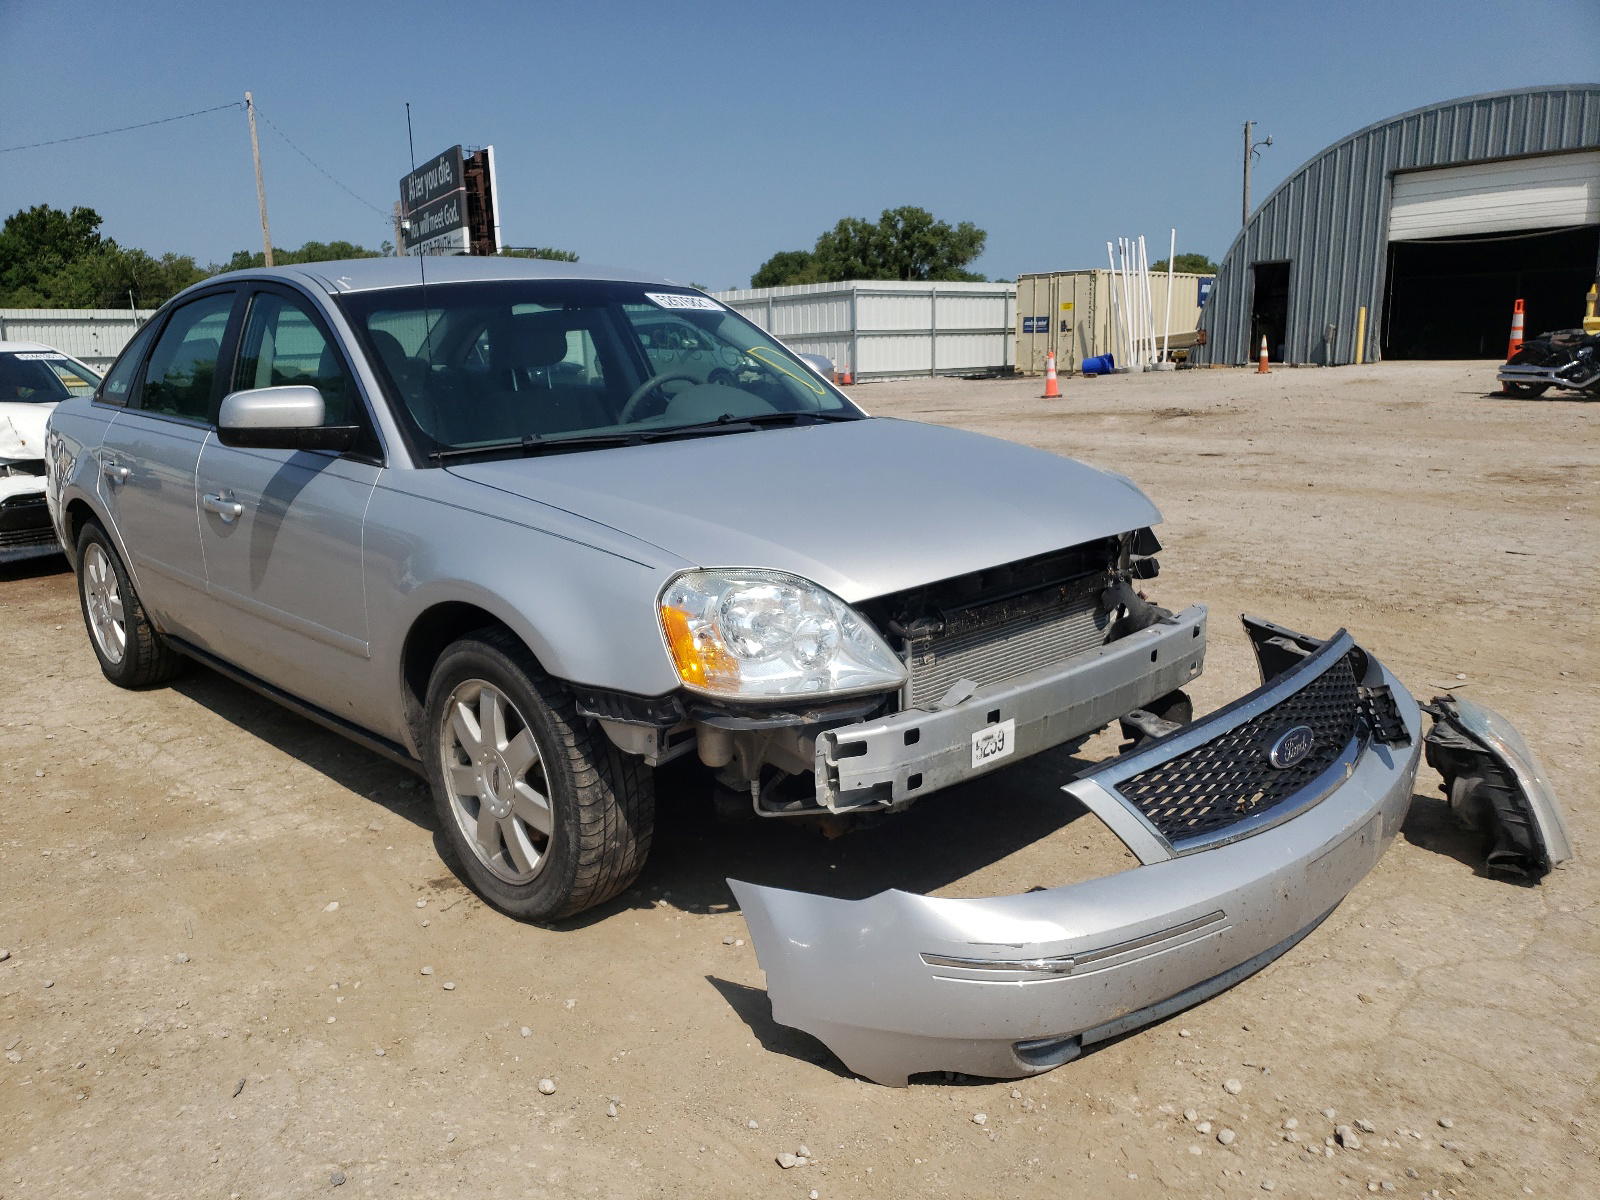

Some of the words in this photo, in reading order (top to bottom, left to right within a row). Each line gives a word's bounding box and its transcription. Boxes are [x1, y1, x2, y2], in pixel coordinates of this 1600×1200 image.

[425, 170, 438, 200] you
[438, 157, 453, 184] die,
[429, 210, 444, 230] meet
[1284, 734, 1307, 762] Ford
